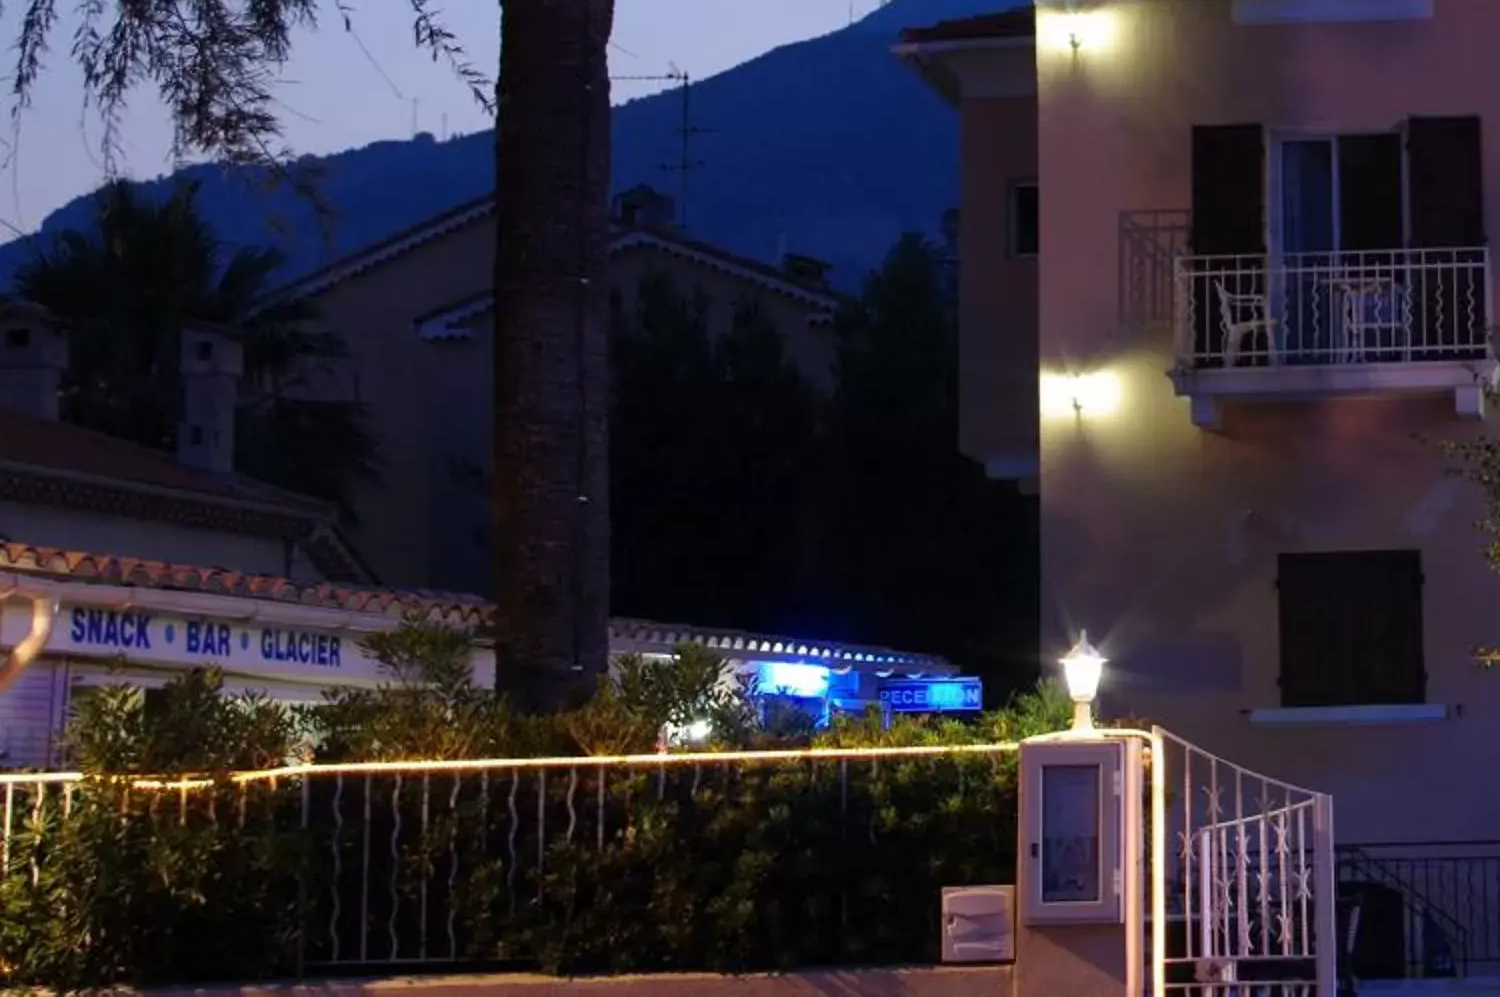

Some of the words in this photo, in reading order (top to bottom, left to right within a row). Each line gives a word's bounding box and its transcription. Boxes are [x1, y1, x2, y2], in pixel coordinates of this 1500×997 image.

[70, 607, 151, 649] SNACK
[186, 620, 231, 657] BAR
[261, 628, 340, 667] GLACIER
